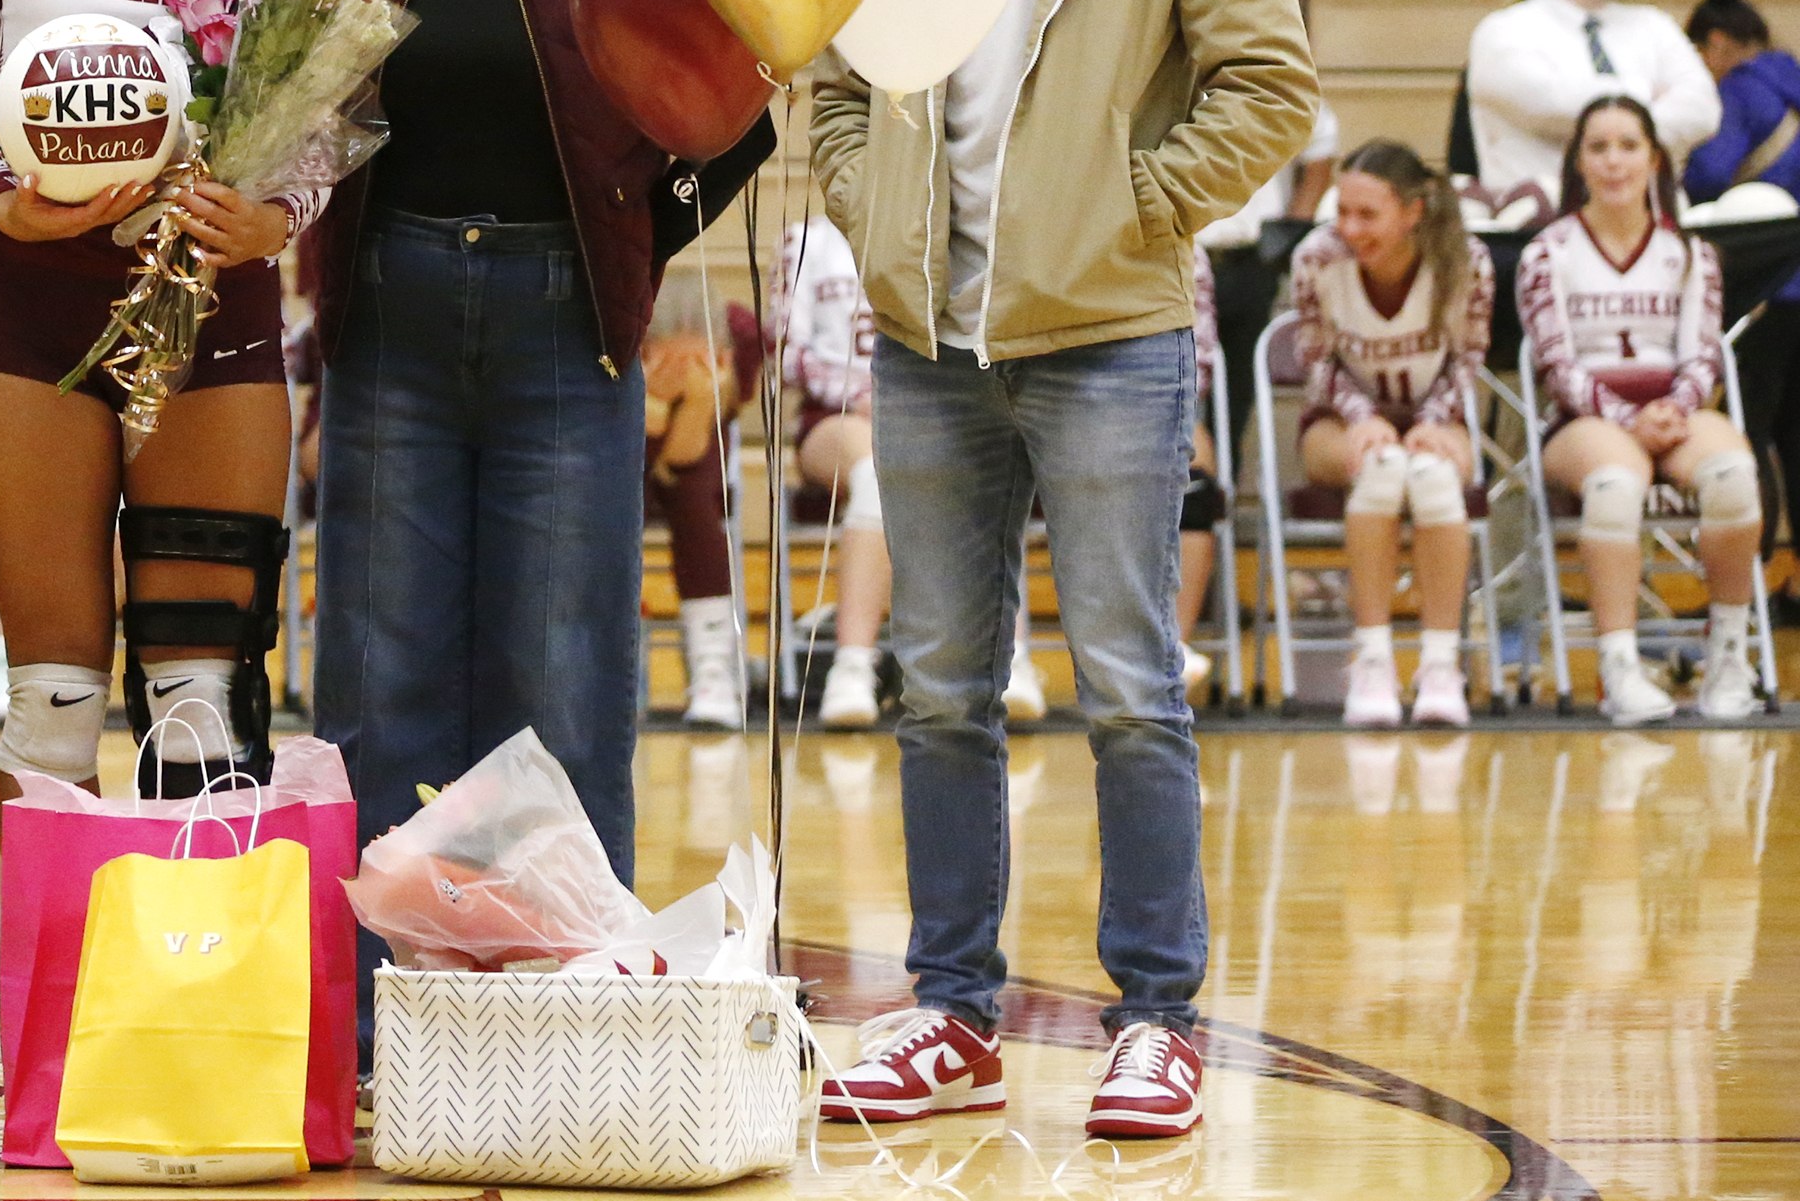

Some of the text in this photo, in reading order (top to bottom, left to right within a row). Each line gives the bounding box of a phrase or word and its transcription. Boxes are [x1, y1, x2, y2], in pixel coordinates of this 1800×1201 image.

[38, 49, 158, 81] Vienna
[55, 83, 141, 123] KHS
[39, 131, 149, 161] Pahang
